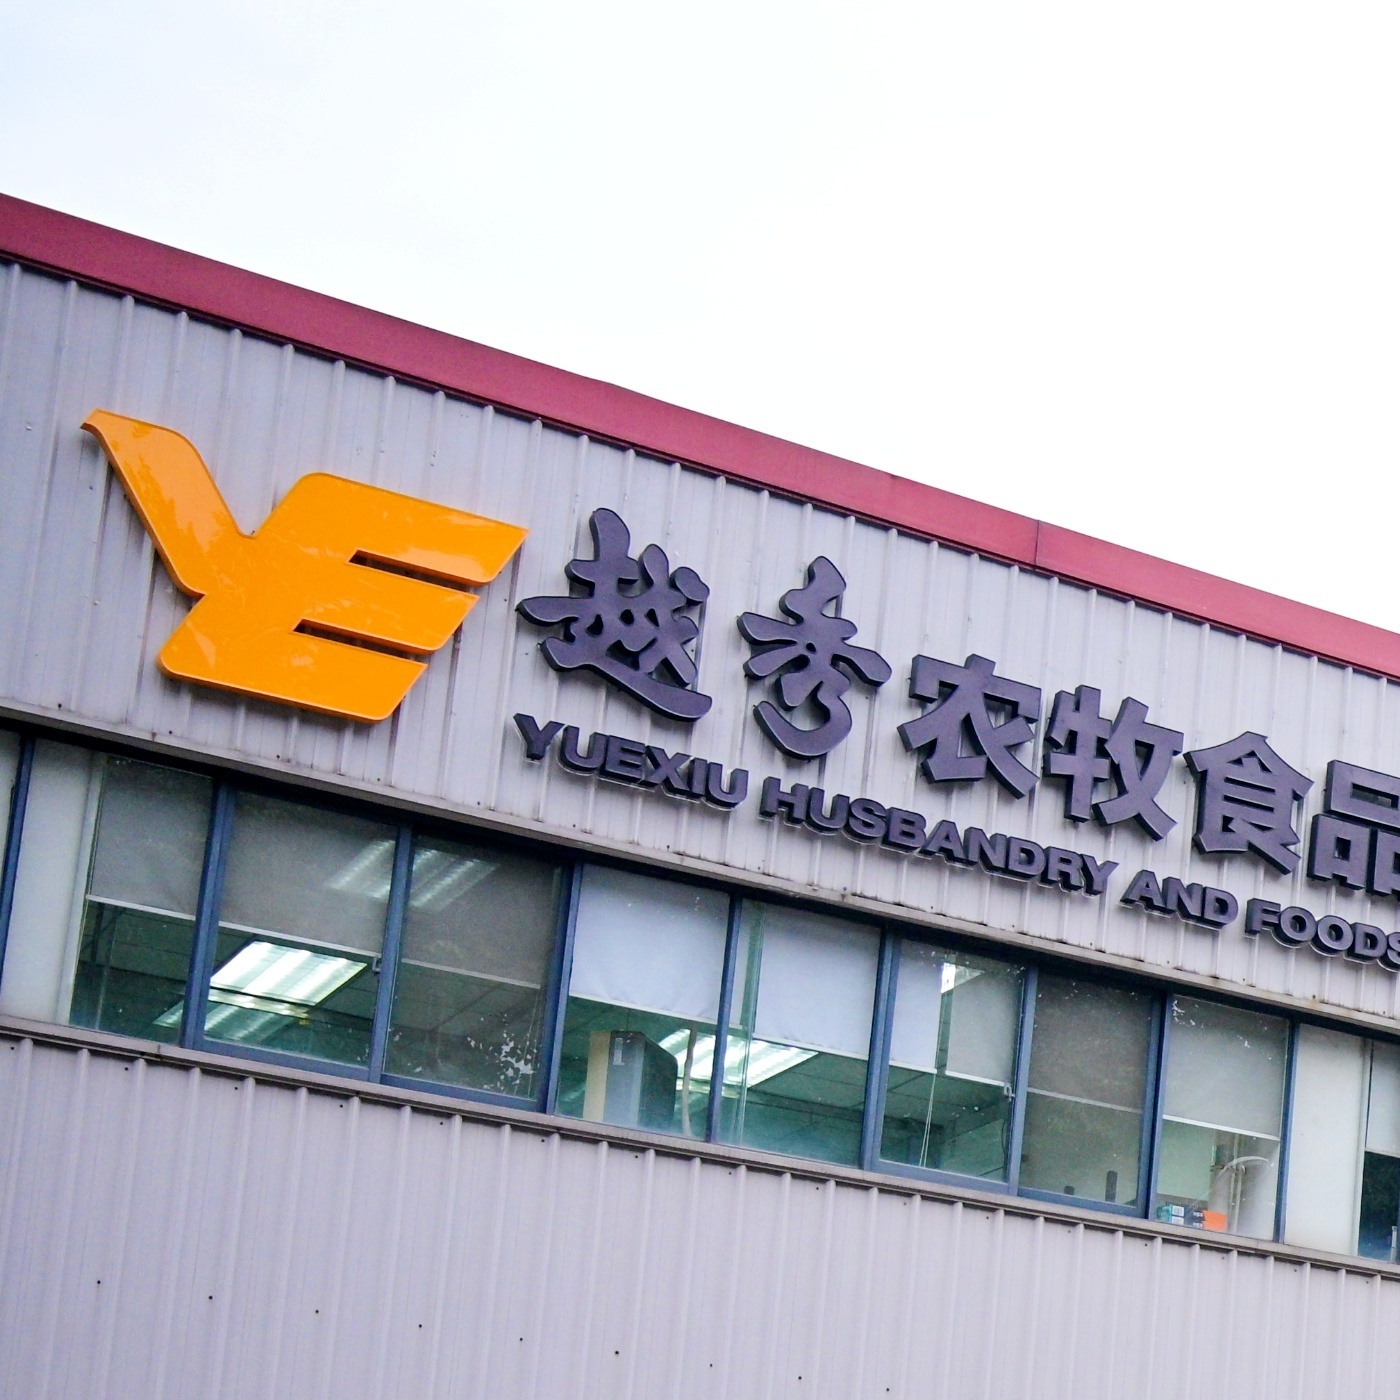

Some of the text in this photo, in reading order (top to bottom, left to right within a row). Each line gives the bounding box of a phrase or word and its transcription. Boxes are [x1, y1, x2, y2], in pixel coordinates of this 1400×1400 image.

[513, 712, 749, 809] YUEXIU
[759, 775, 1119, 897] HUSBANDRY
[1120, 869, 1239, 930] AND
